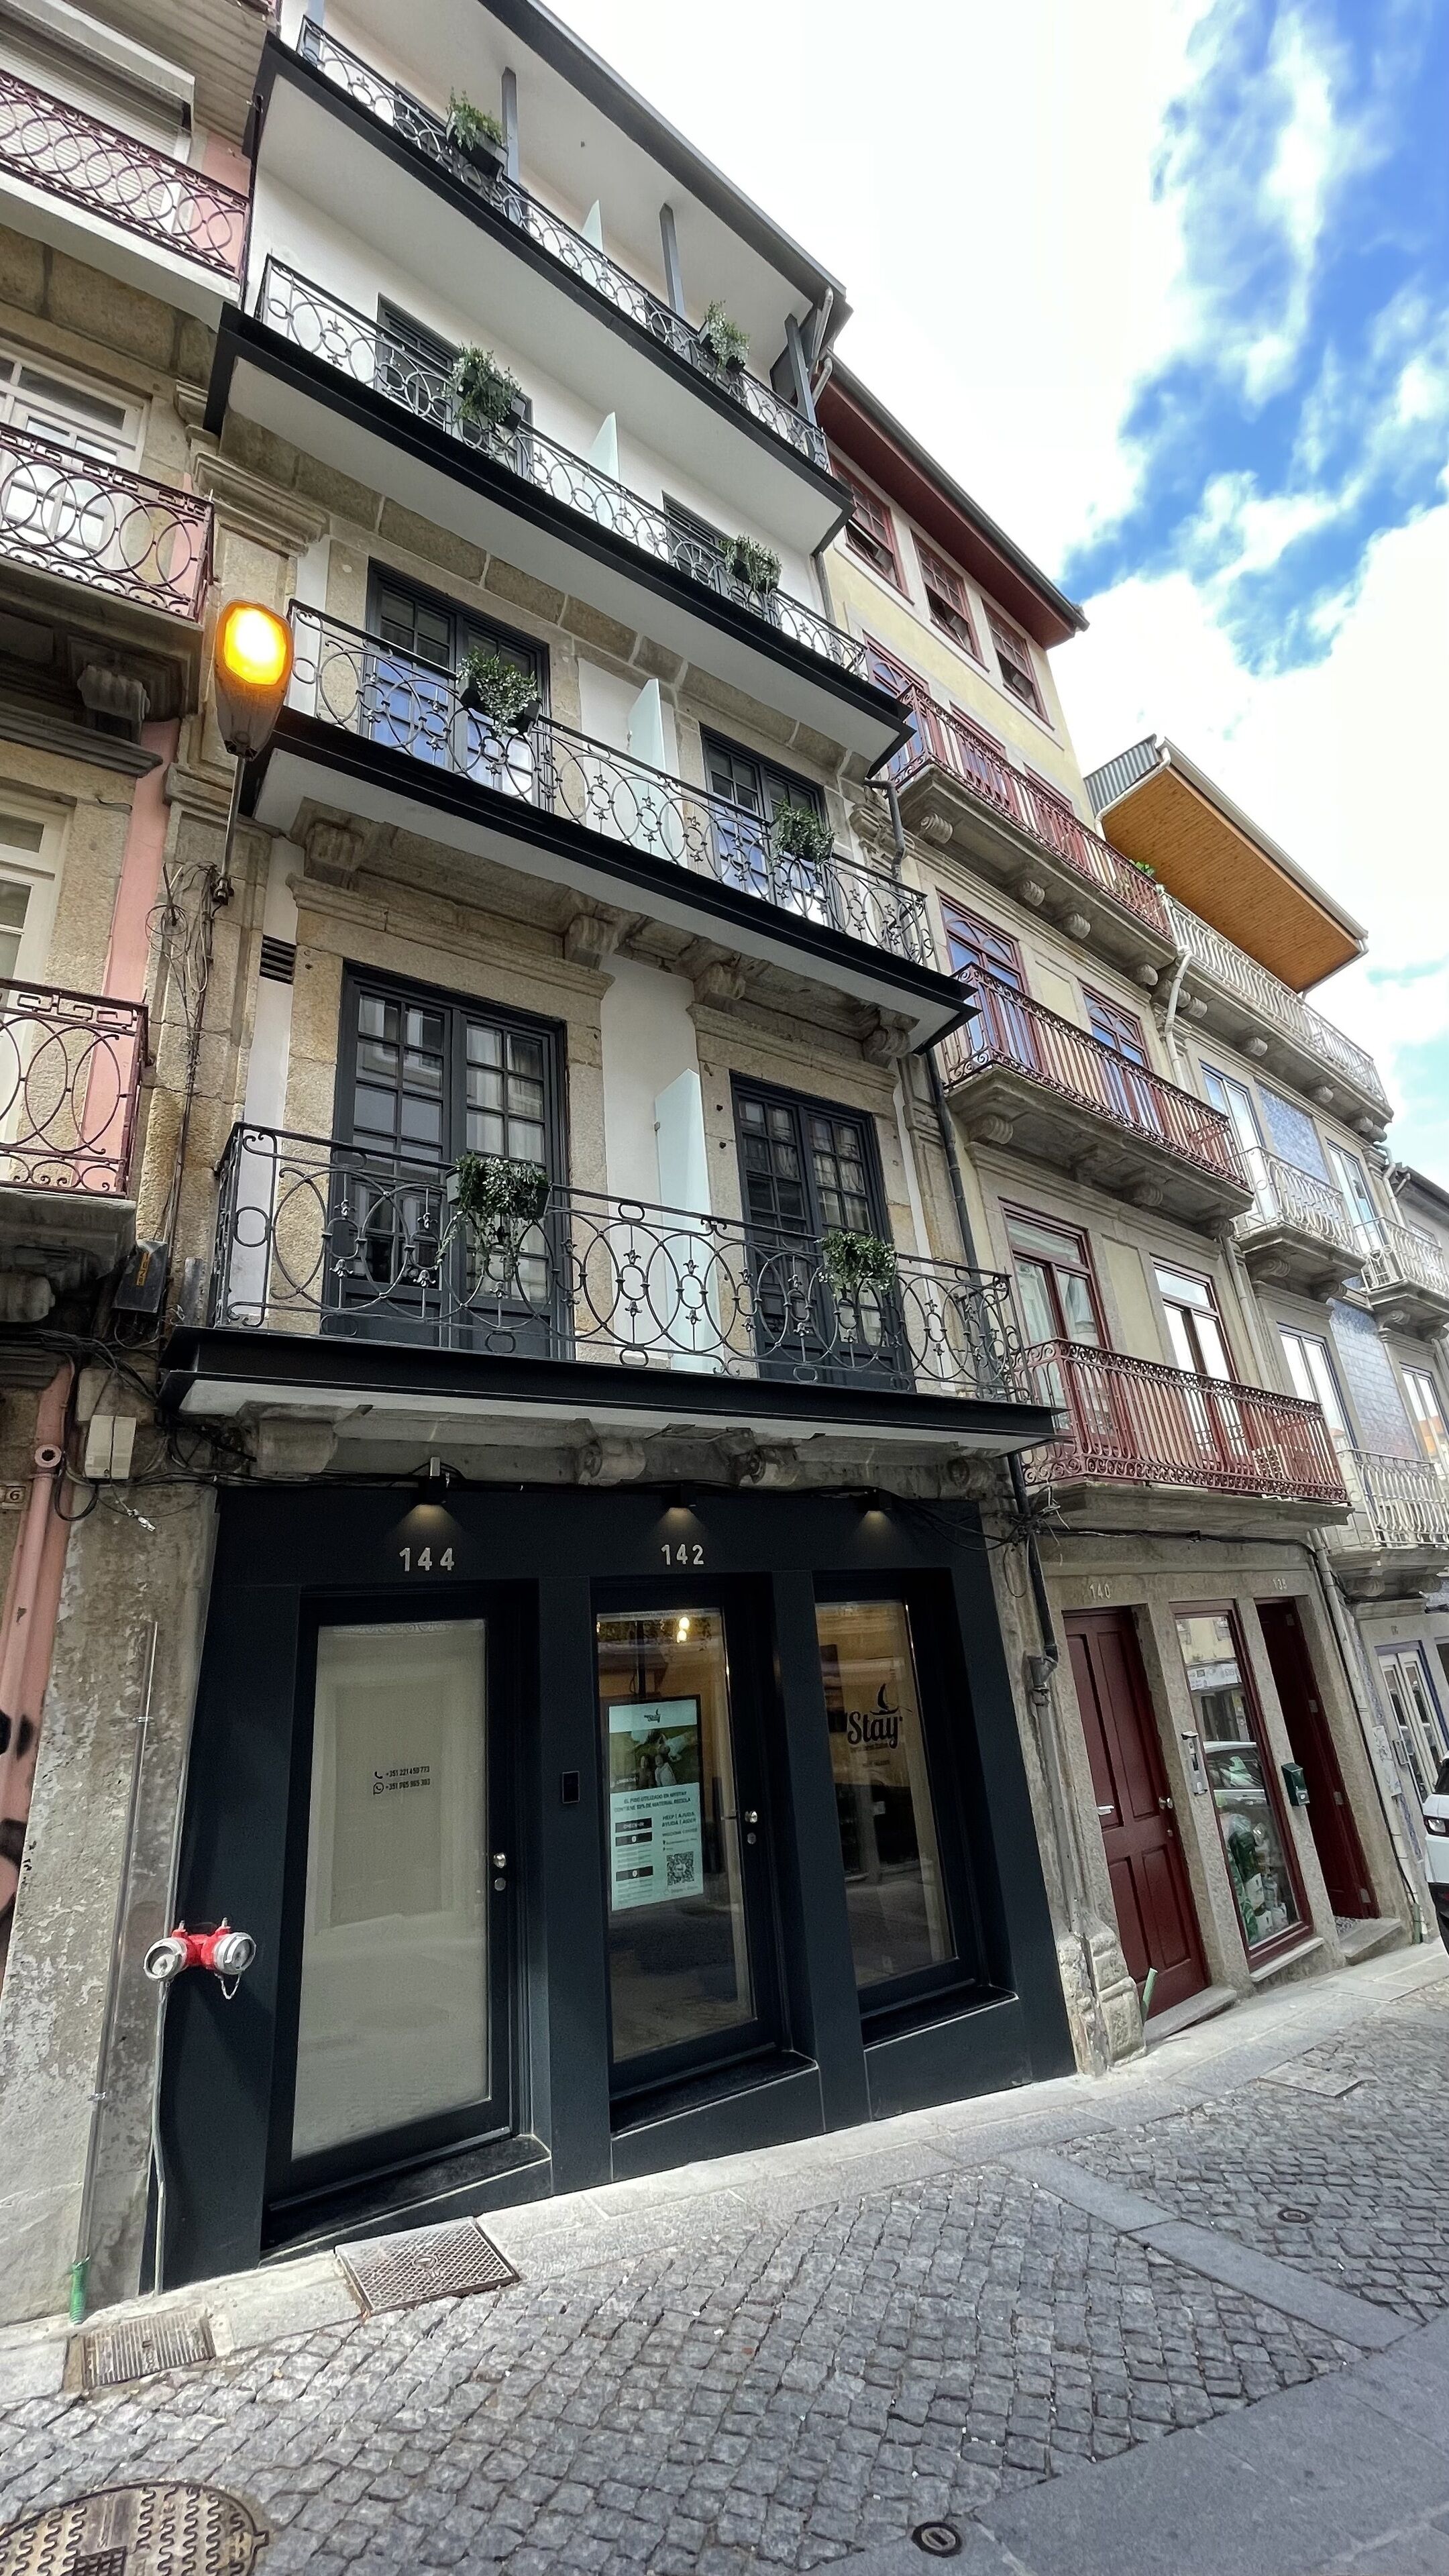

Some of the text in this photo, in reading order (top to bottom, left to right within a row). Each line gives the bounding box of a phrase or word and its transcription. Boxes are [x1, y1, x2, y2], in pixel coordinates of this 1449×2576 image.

[399, 1547, 455, 1572] 144
[661, 1544, 704, 1565] 142
[1089, 1583, 1111, 1599] 140
[847, 1711, 900, 1749] Stay
